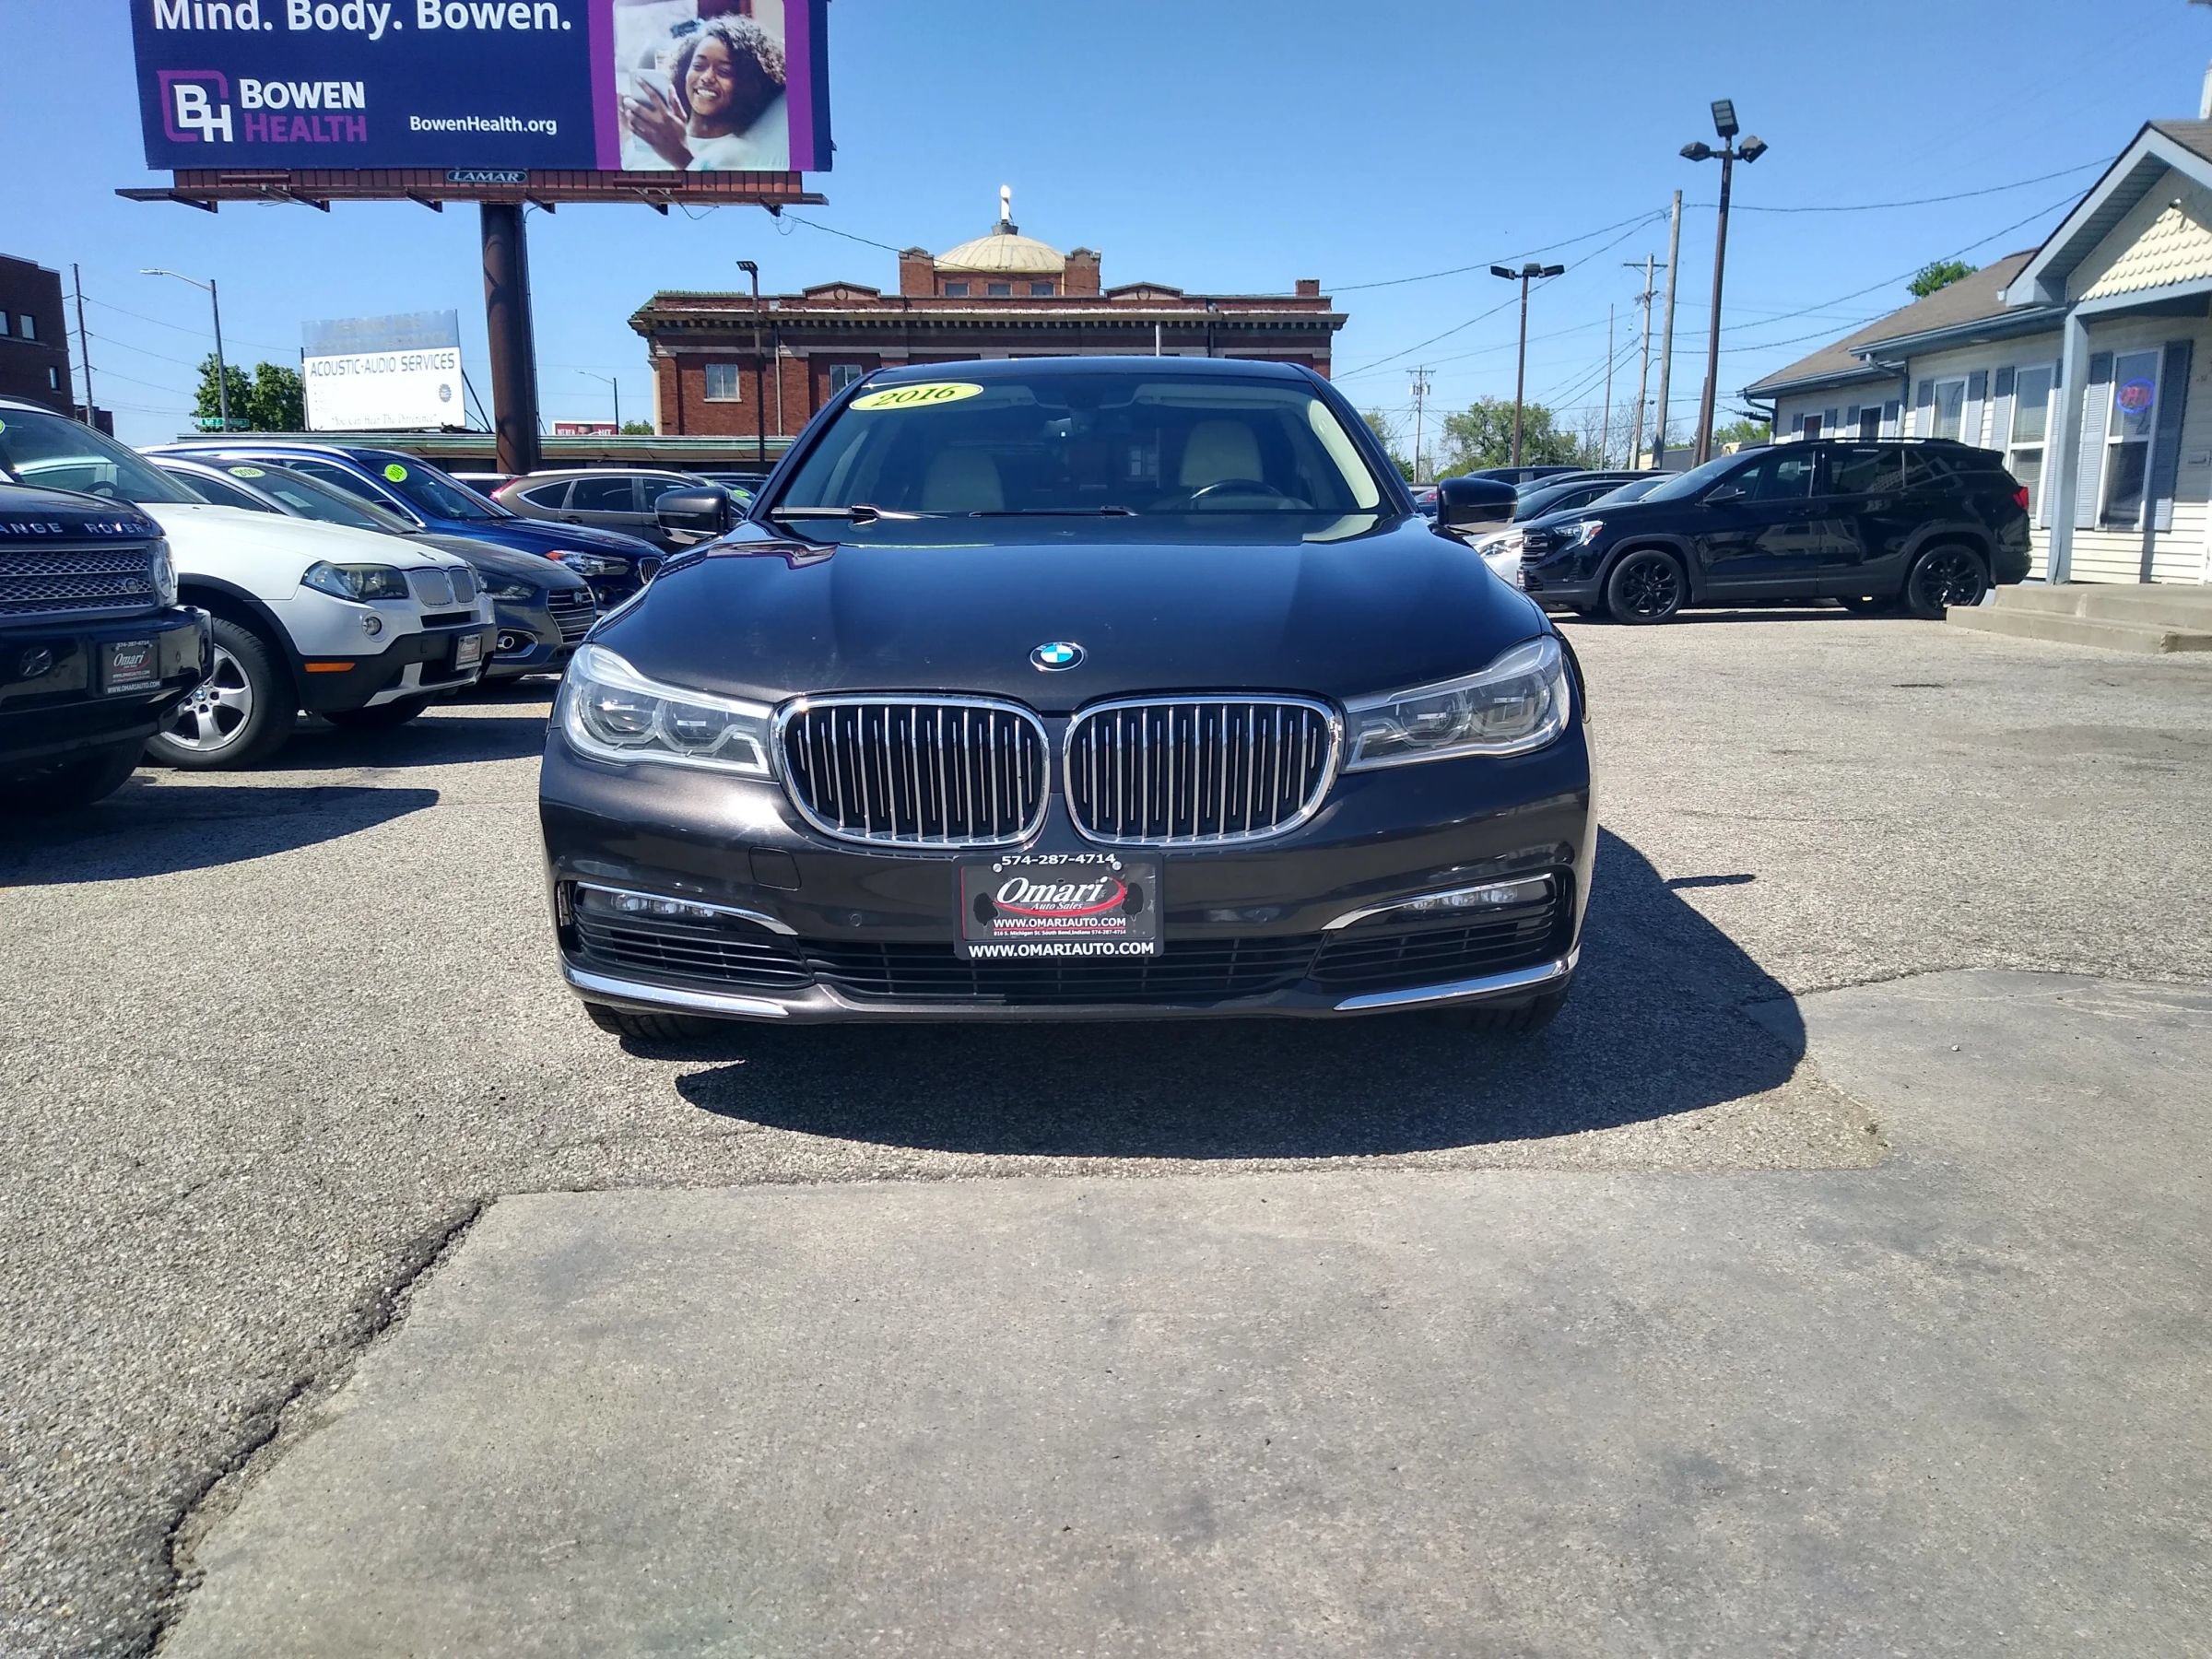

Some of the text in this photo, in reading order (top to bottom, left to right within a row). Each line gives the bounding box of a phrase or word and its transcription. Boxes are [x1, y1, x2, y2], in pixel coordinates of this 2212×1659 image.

[153, 0, 571, 41] Mind. Body. Bowen.
[239, 78, 367, 109] BOWEN
[173, 84, 234, 142] BH
[243, 112, 368, 142] HEALTH
[409, 116, 558, 135] BowenHealth.org
[453, 171, 519, 182] LAMAR
[401, 352, 455, 372] SERVICES
[871, 385, 961, 407] 2016
[84, 522, 145, 535] ROVER
[113, 651, 146, 666] Omari
[1001, 853, 1115, 865] 574-287-4714
[995, 876, 1108, 904] Omari
[1031, 901, 1083, 911] Auto Sales
[993, 917, 1126, 928] WWW.OMARIAUTO.COM
[969, 942, 1154, 958] WWW.OMARIAUTO.COM
